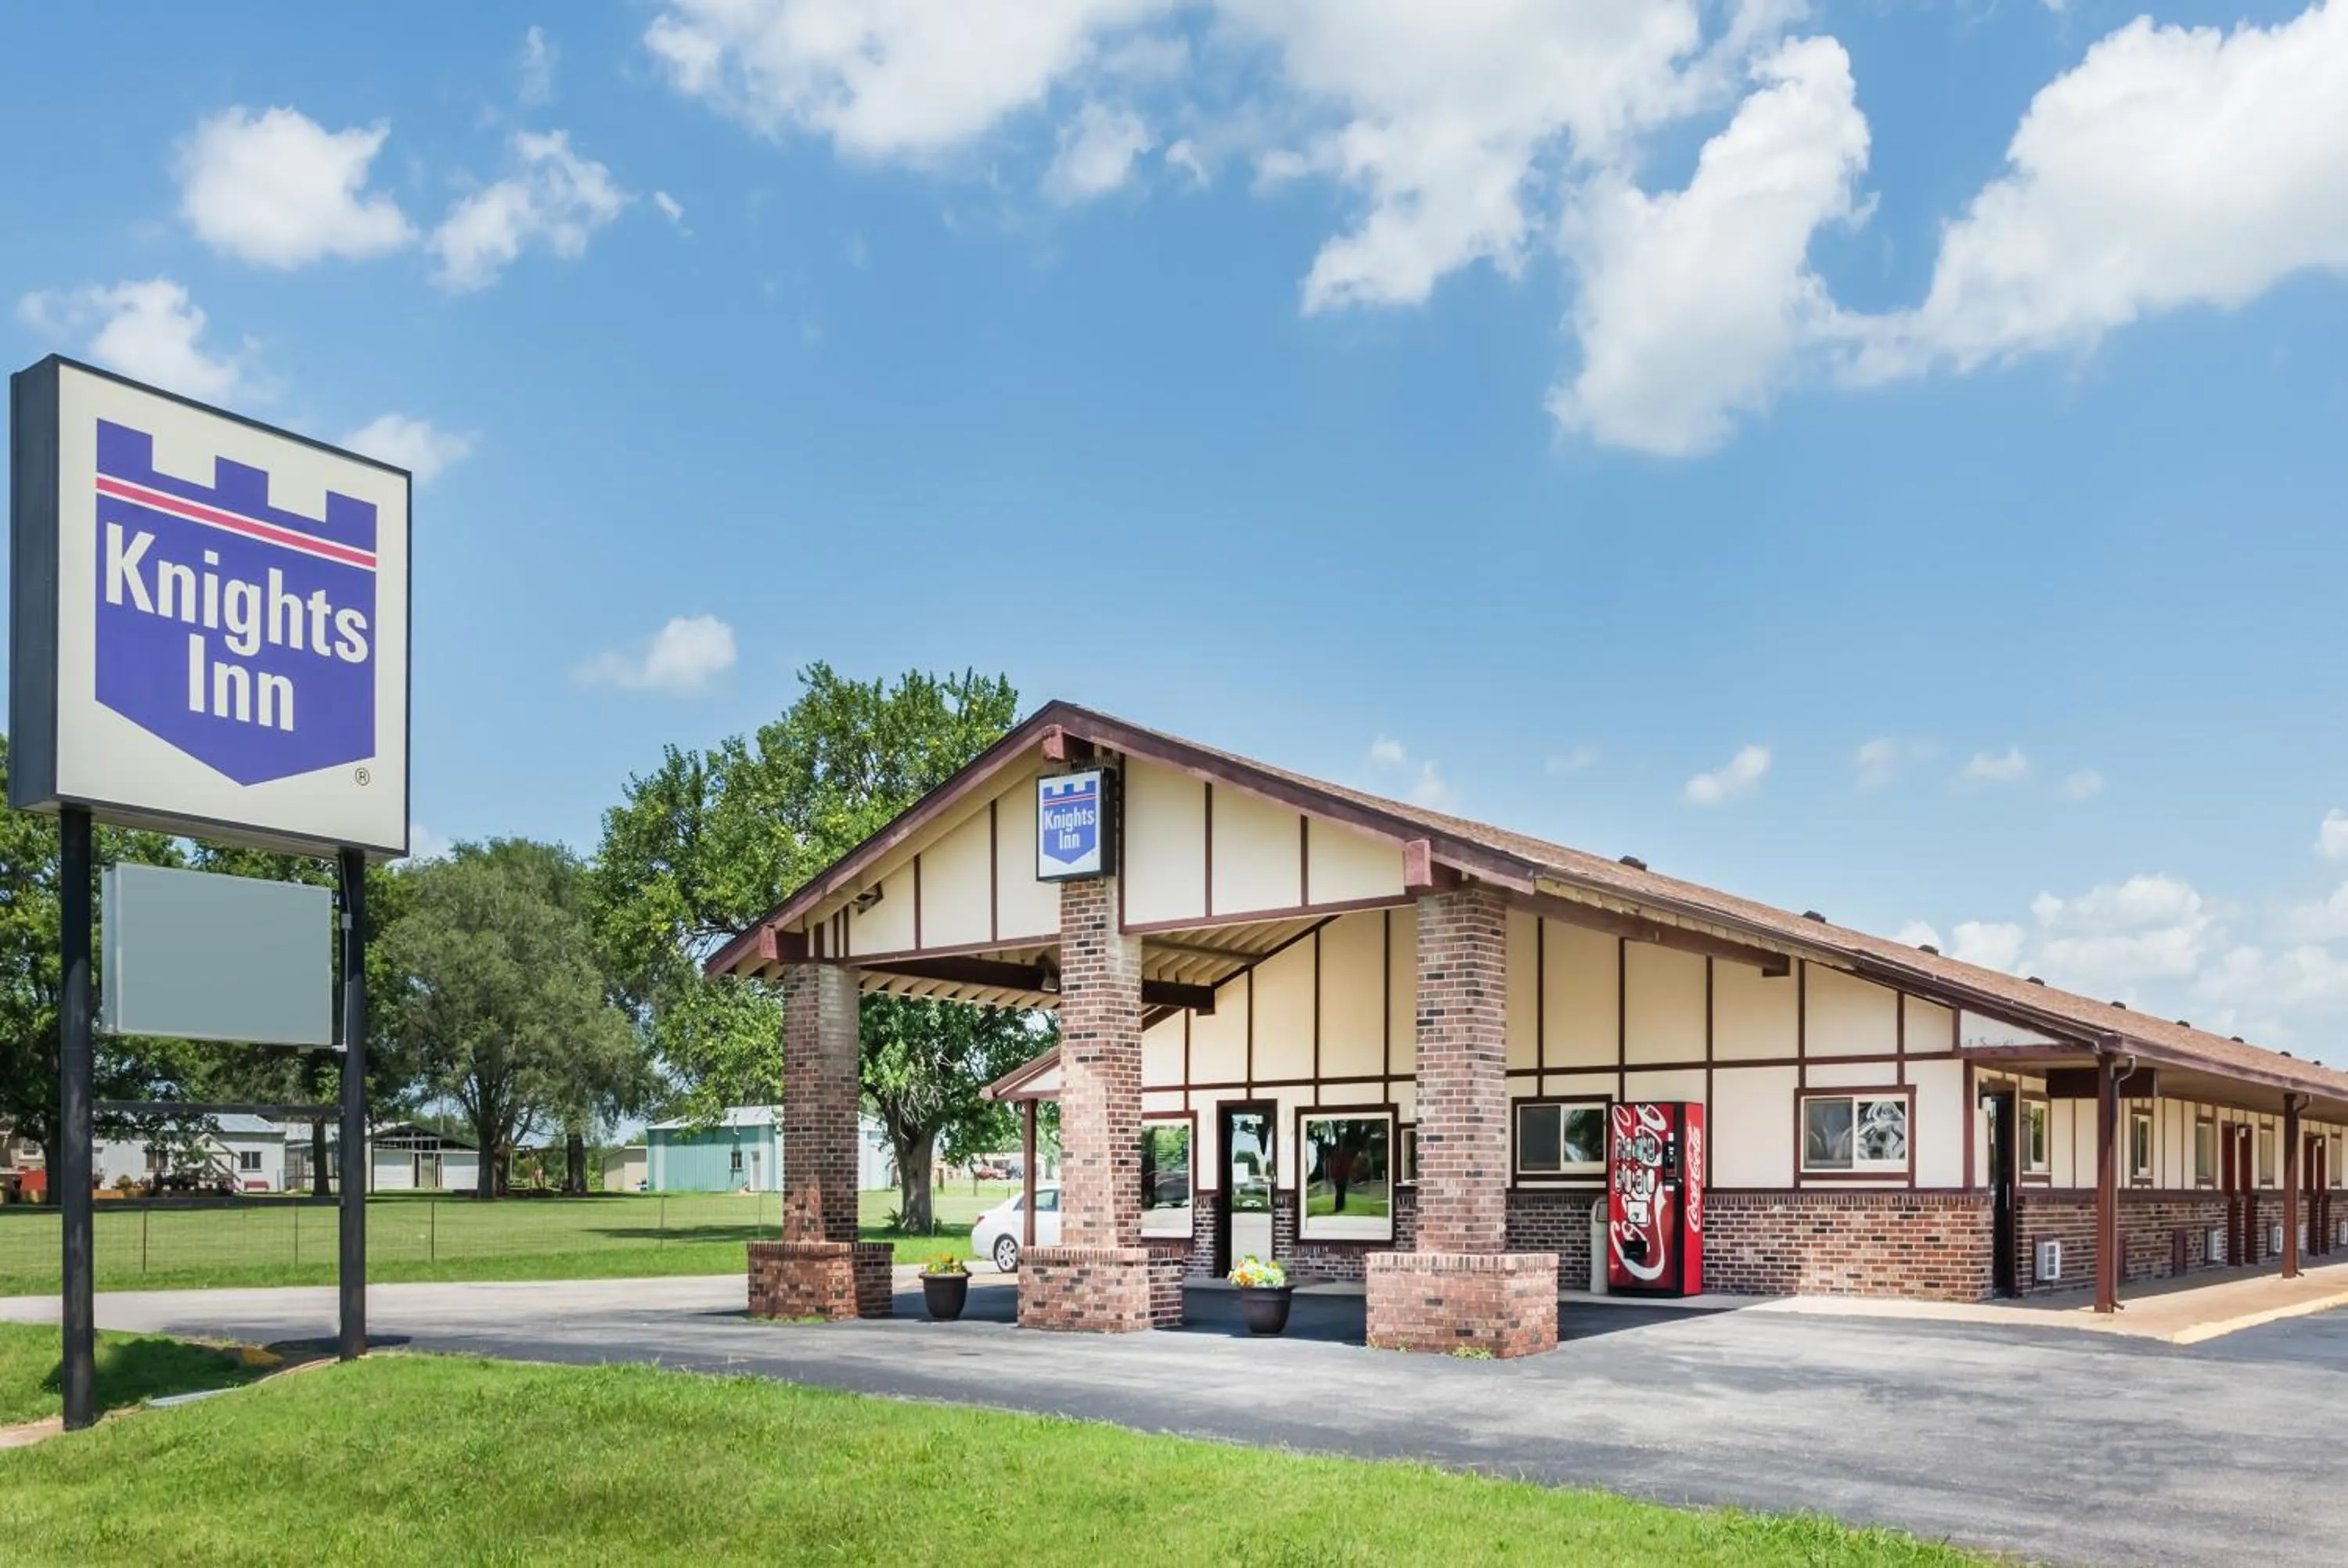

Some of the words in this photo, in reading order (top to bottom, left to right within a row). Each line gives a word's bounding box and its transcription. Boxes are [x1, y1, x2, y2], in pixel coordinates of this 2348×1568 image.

[106, 522, 369, 664] Knights
[189, 633, 294, 732] Inn
[1044, 807, 1095, 832] Knights
[1059, 829, 1080, 851] Inn
